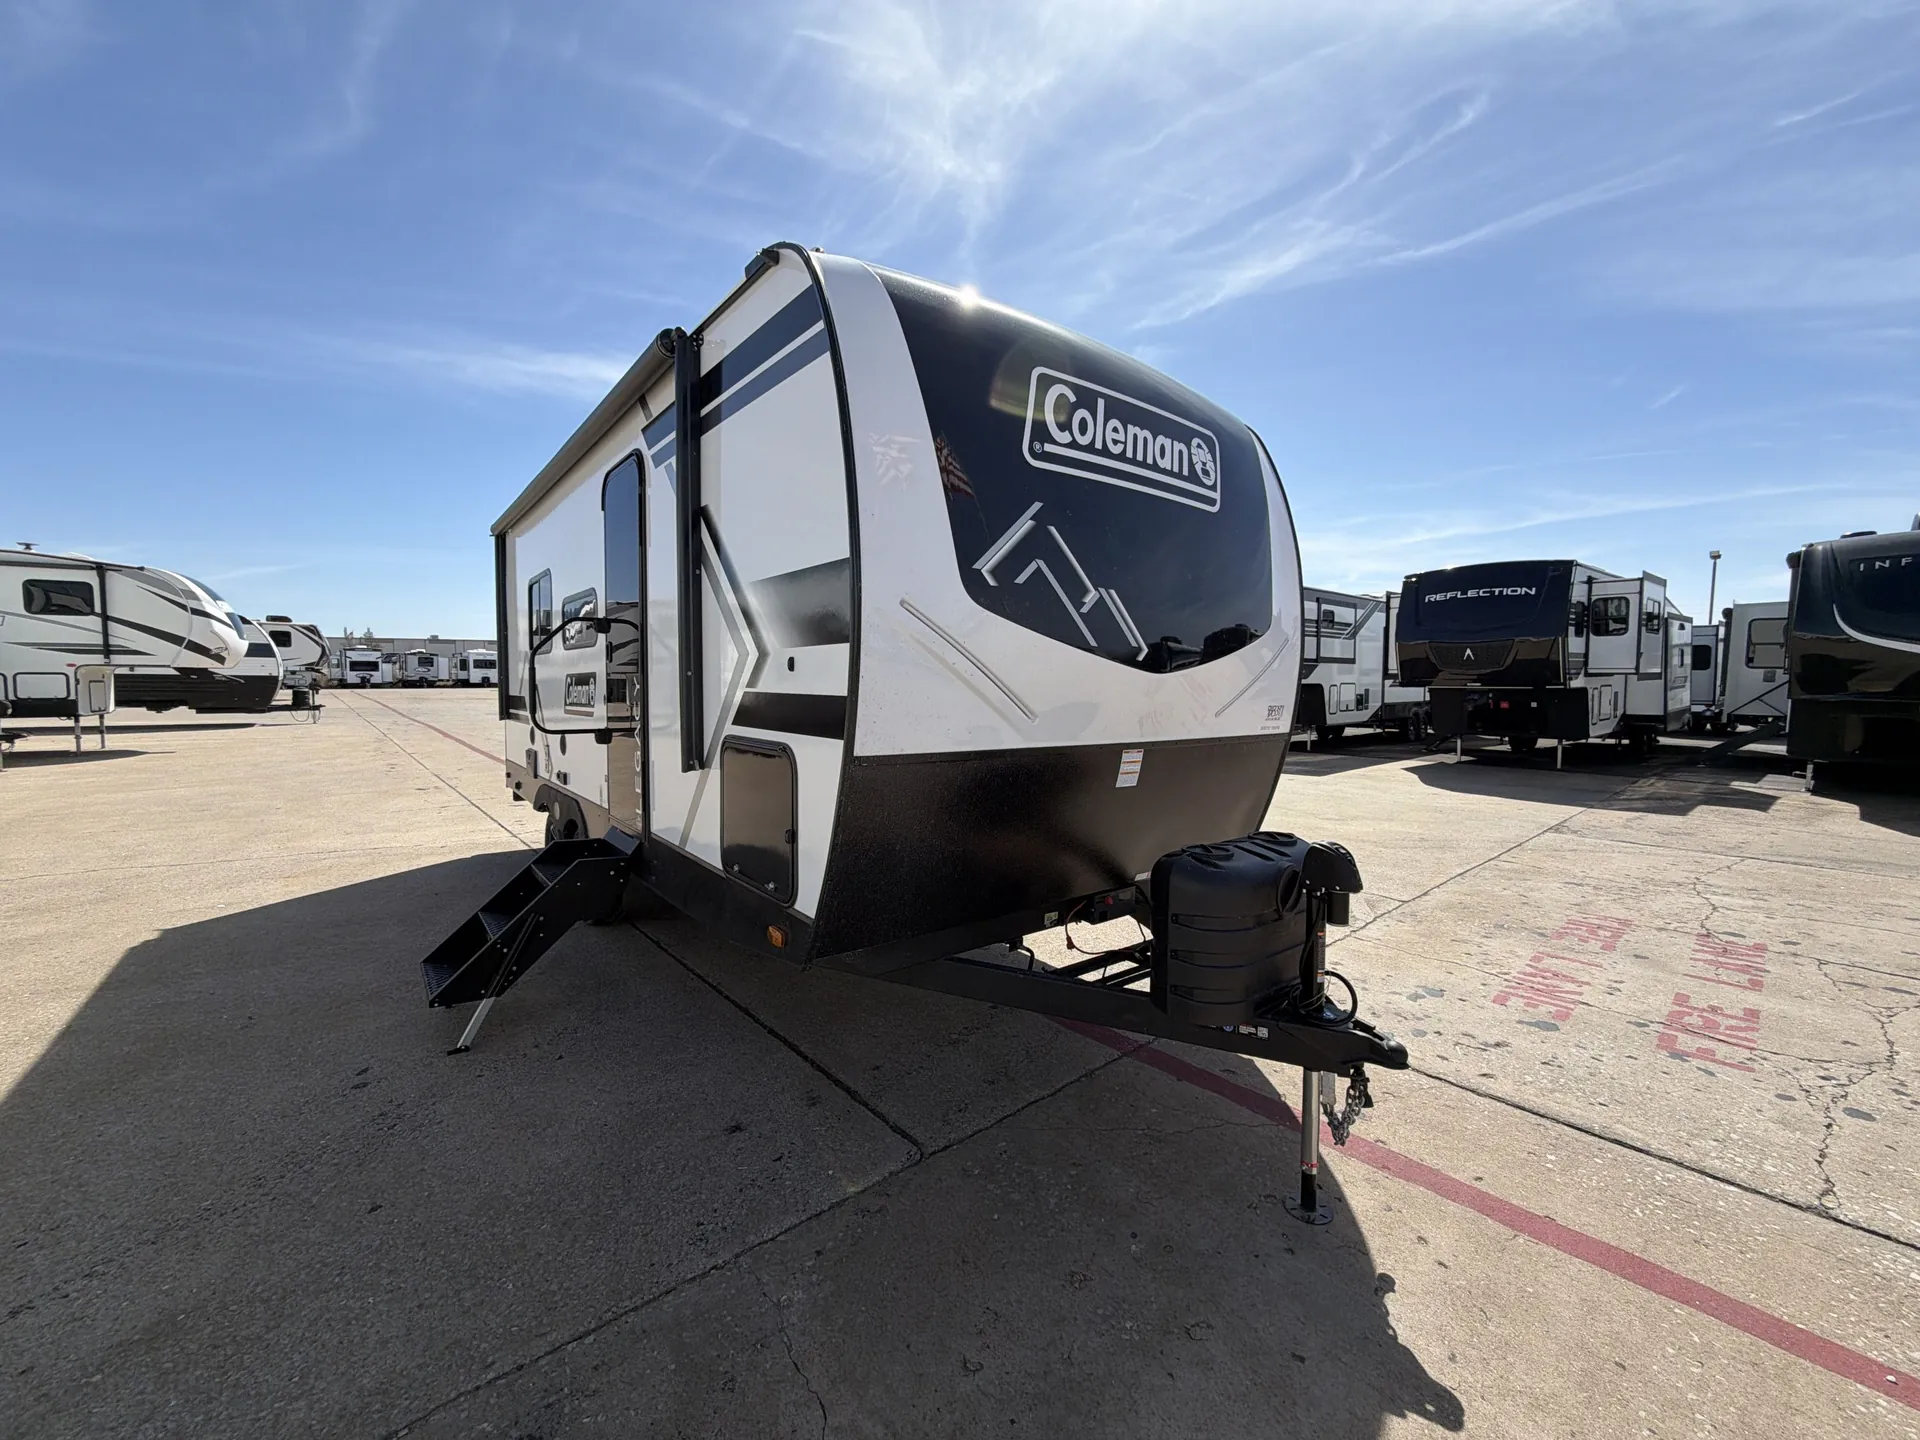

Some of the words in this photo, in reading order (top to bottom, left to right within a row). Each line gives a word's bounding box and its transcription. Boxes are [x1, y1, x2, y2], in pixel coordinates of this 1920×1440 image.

[1044, 383, 1189, 477] Coleman
[1425, 587, 1536, 603] REFLECTION
[566, 676, 589, 705] Coleman
[1492, 951, 1605, 1022] LANE
[1682, 933, 1768, 992] LANE
[1656, 992, 1761, 1073] FIRE
